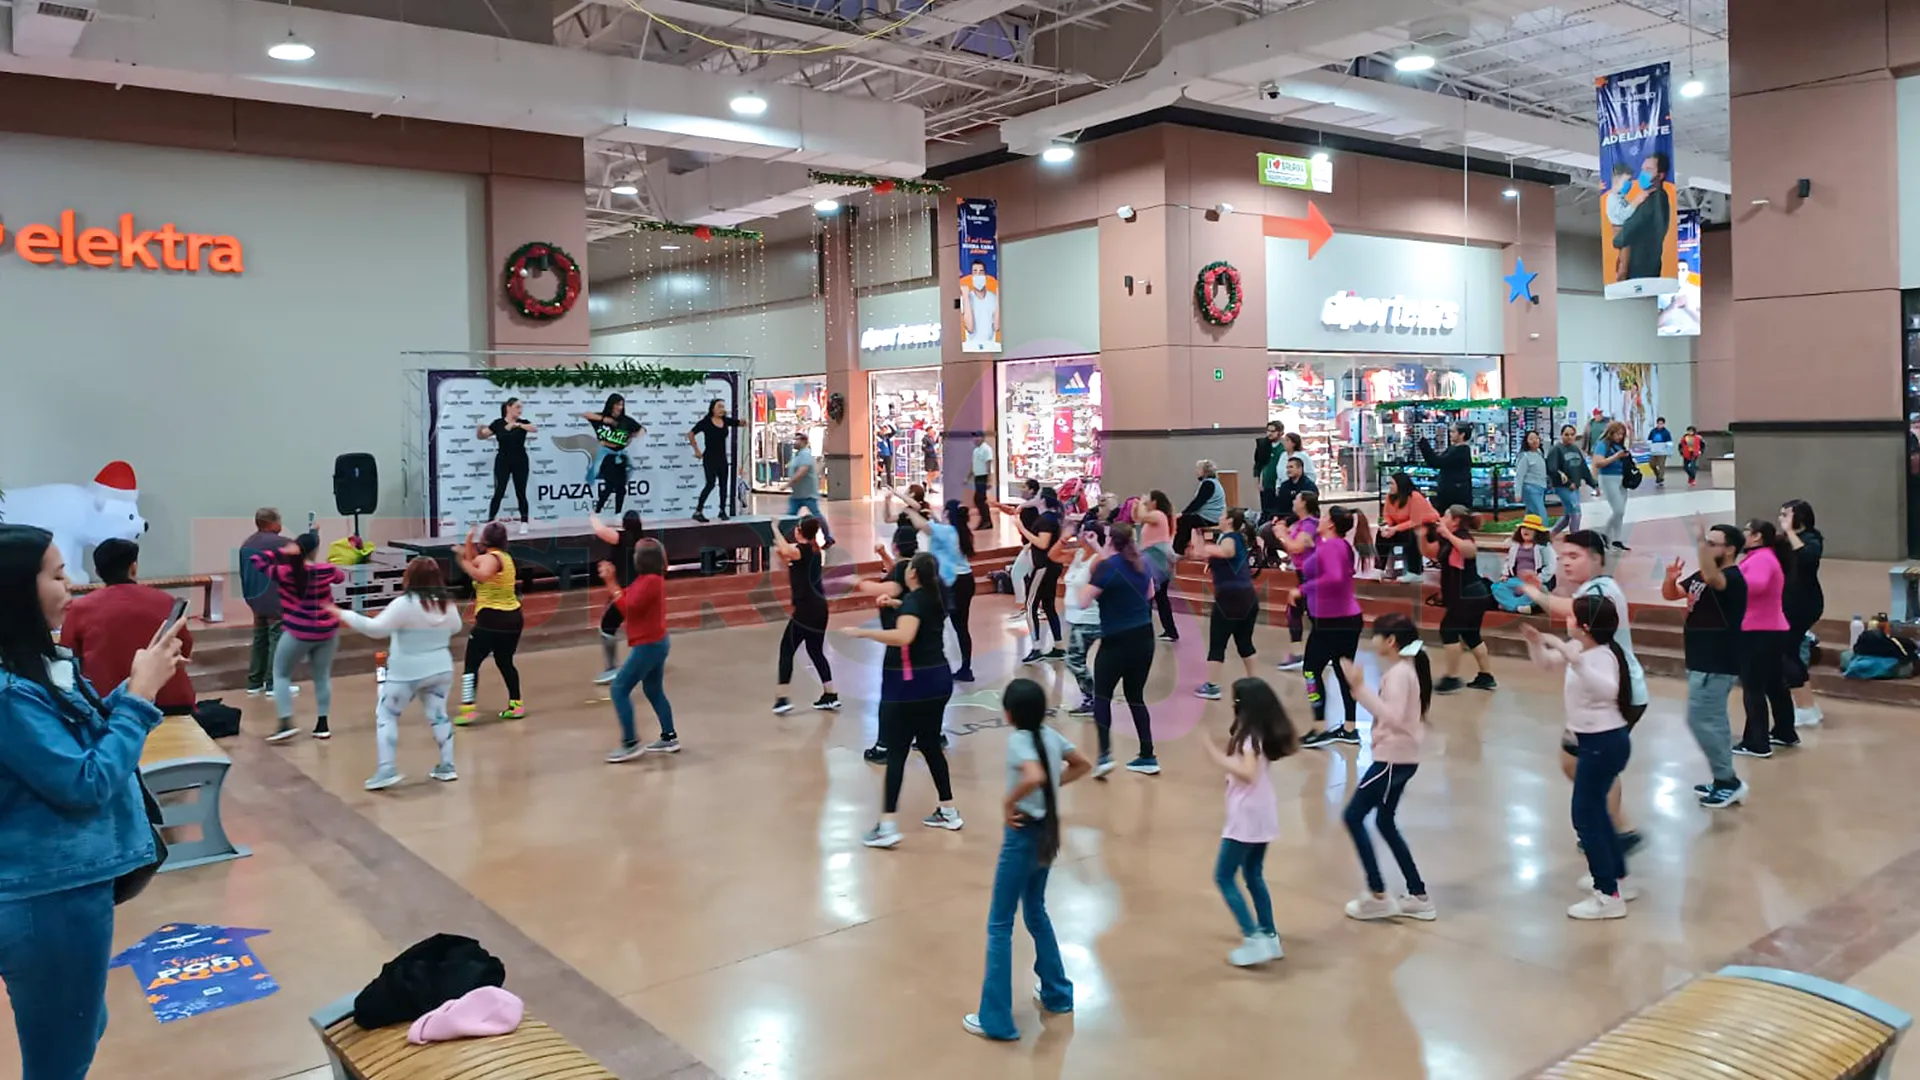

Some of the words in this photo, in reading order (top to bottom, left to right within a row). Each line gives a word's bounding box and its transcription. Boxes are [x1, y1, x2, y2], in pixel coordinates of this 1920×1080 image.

[1601, 124, 1671, 147] ADELANTE
[15, 208, 244, 273] elektra
[538, 484, 593, 501] PLAZA
[598, 480, 650, 499] PEO
[574, 501, 589, 511] LA
[157, 956, 236, 979] POR
